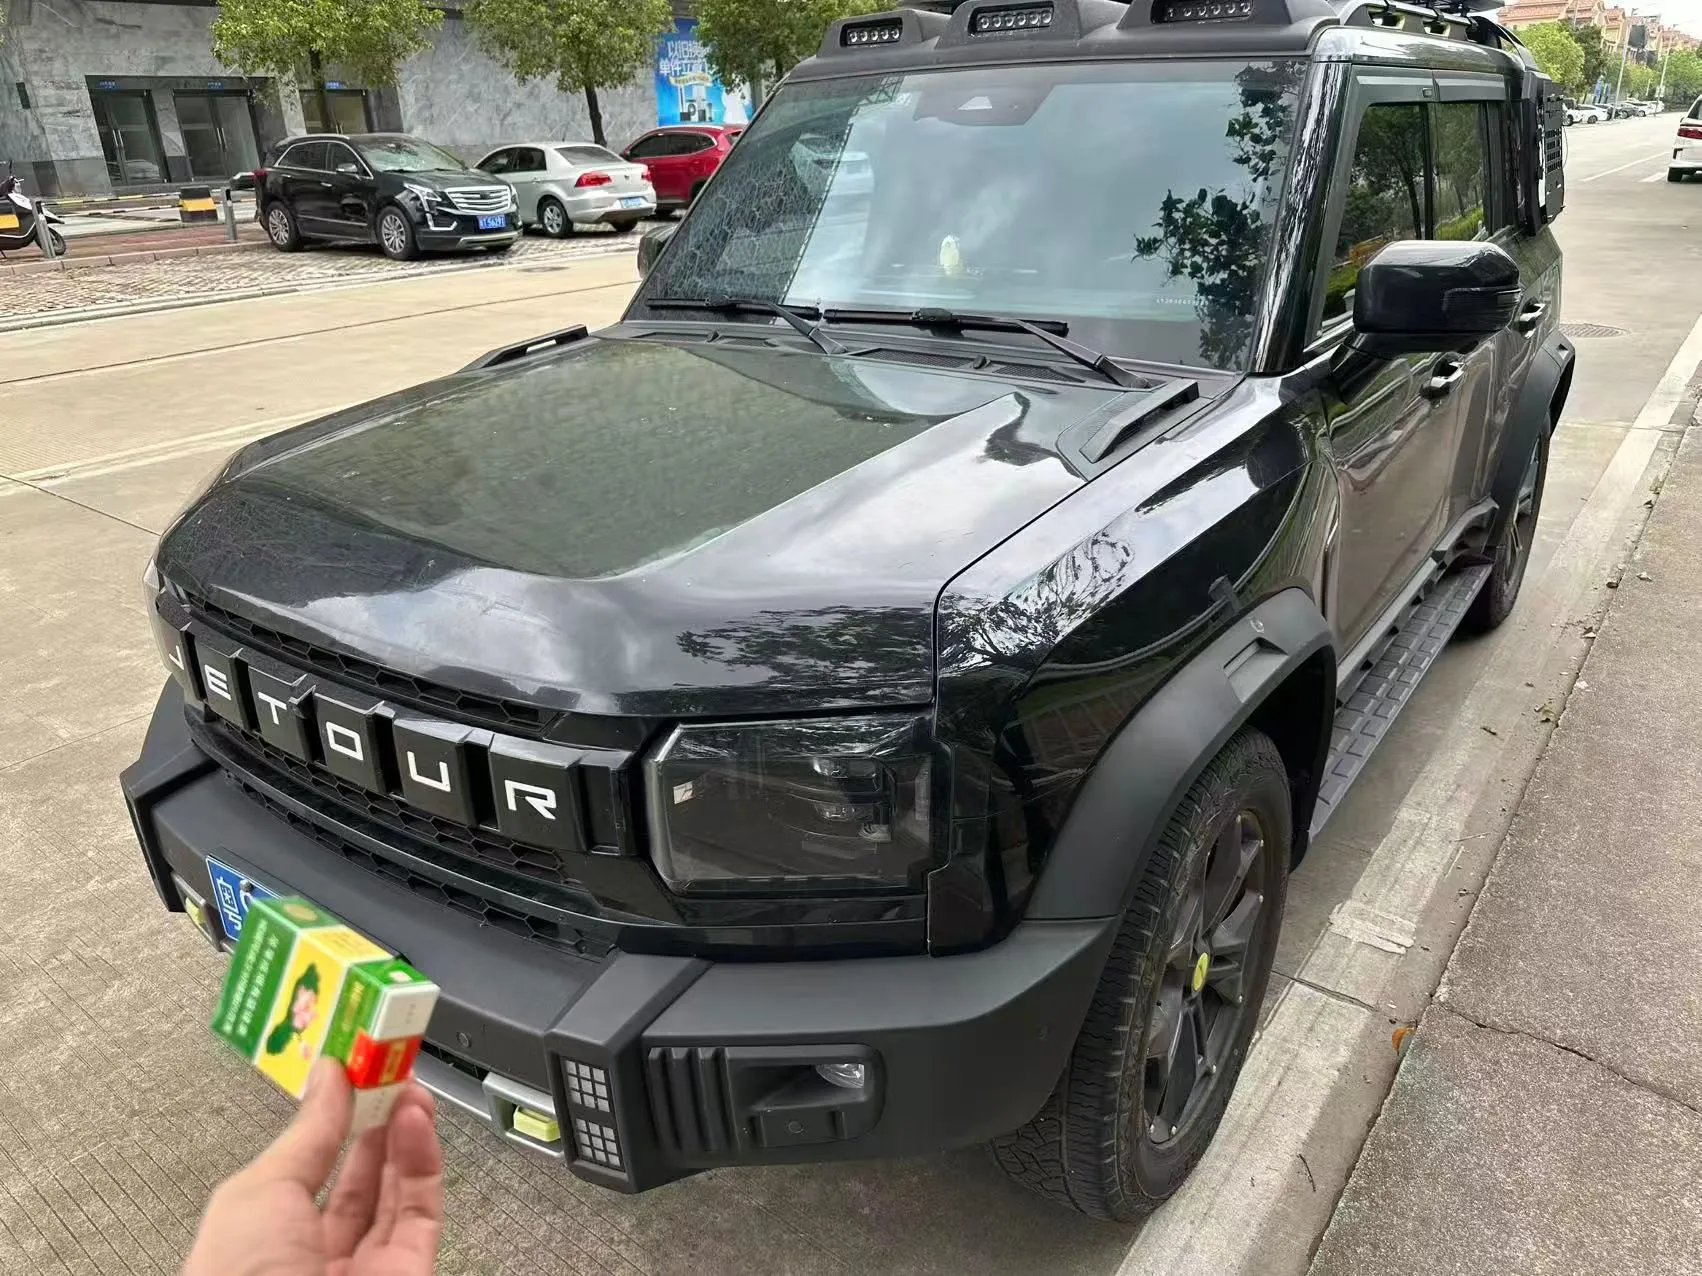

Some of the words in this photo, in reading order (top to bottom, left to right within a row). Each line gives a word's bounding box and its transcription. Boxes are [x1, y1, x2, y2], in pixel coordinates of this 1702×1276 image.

[667, 40, 709, 58] 以旧换
[168, 644, 557, 820] JETOUR
